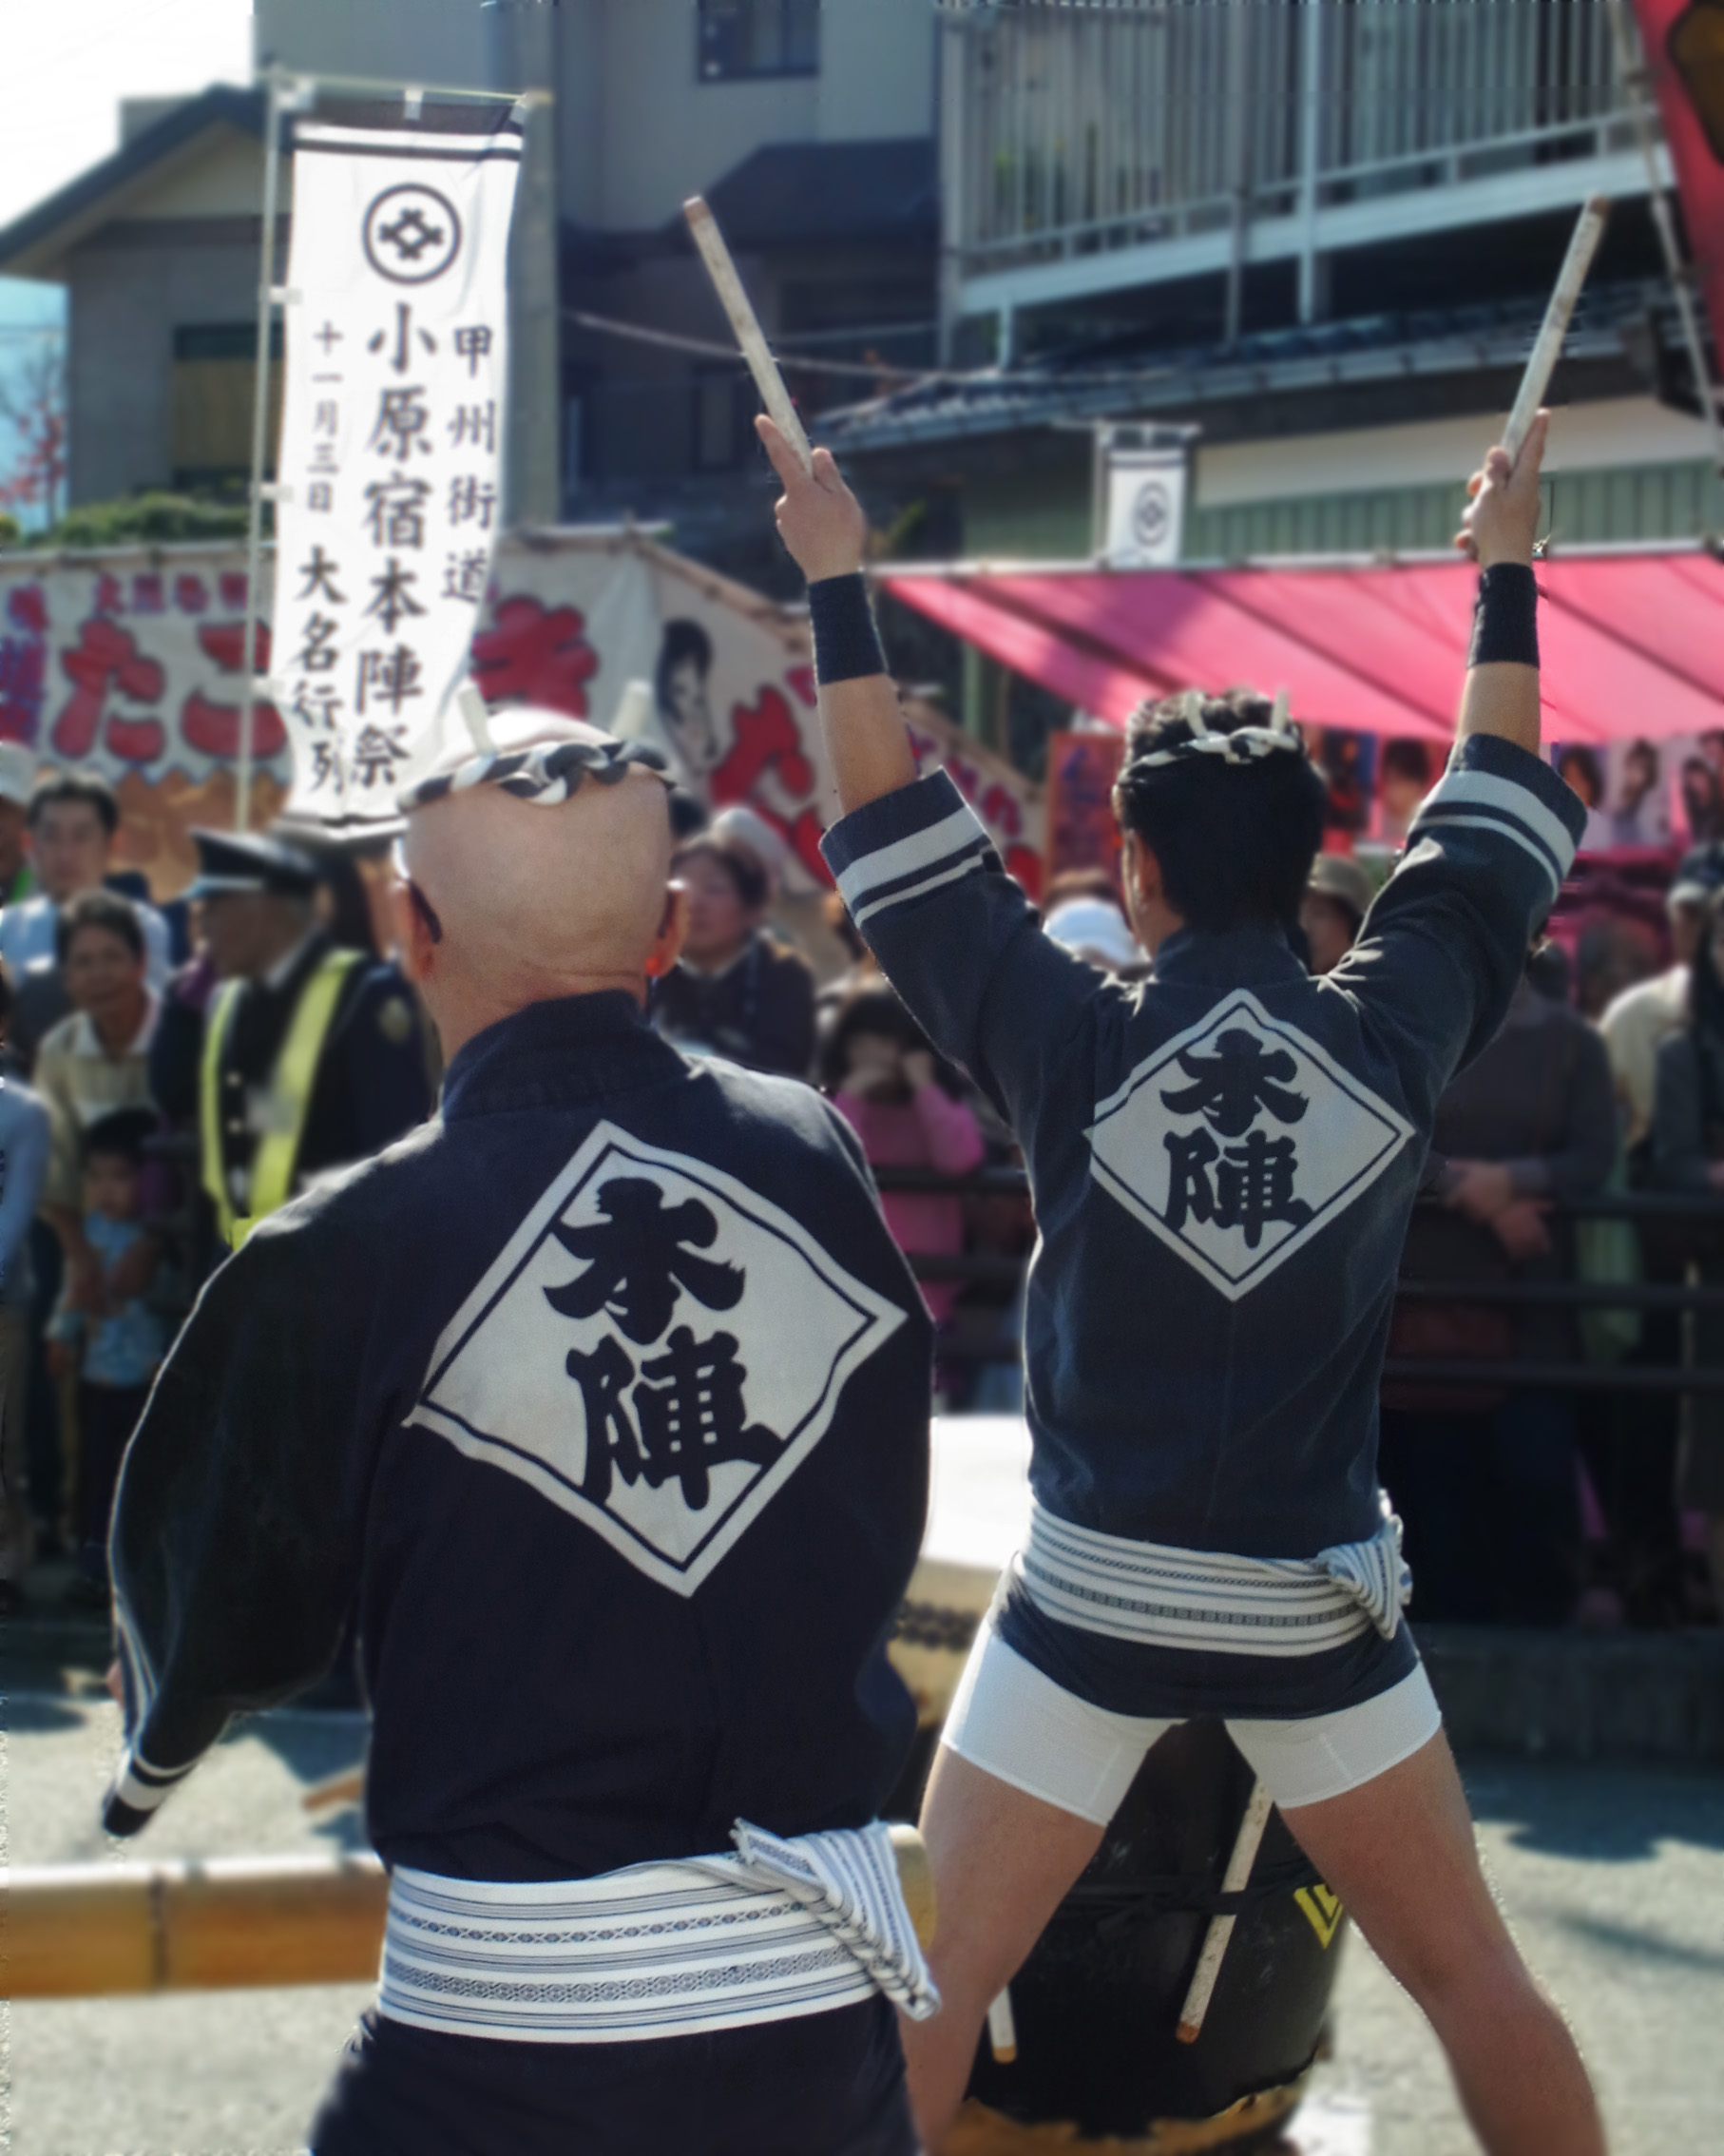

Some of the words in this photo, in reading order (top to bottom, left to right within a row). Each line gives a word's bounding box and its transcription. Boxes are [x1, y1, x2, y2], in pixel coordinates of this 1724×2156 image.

[306, 319, 343, 513] 十一月三日
[351, 301, 437, 788] 小原宿本陣祭
[441, 324, 497, 604] 甲州街道
[288, 545, 348, 795] 大名行列
[1159, 1028, 1314, 1250] 本陣
[542, 1177, 787, 1511] 本陣
